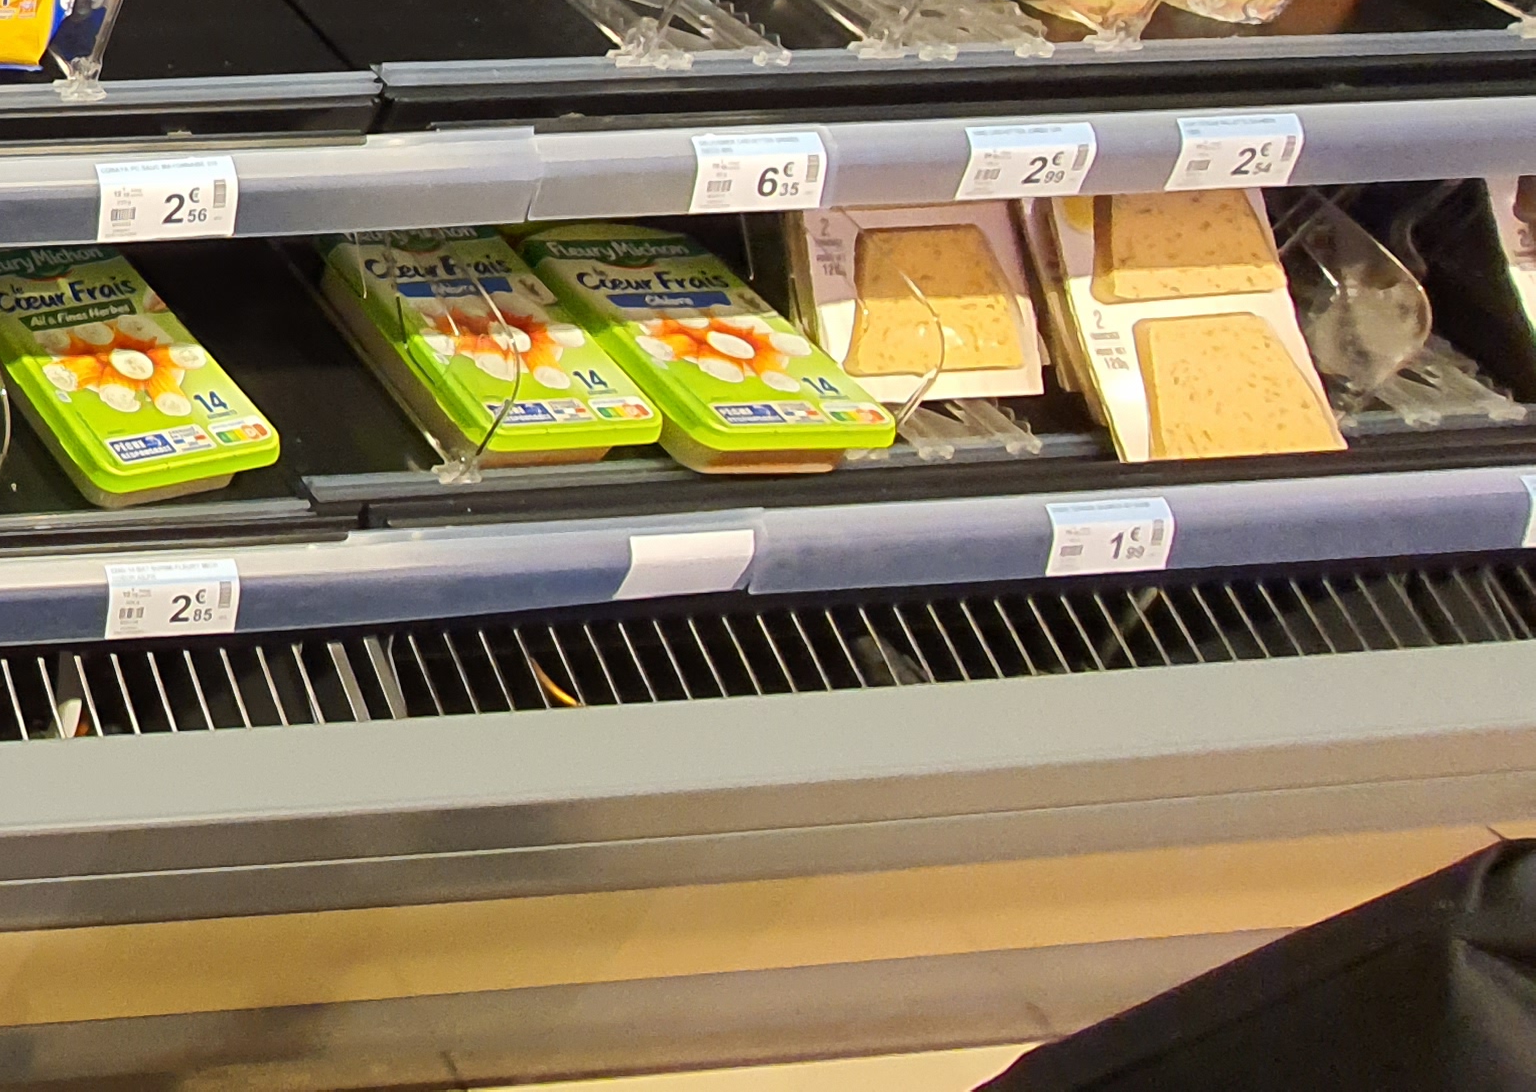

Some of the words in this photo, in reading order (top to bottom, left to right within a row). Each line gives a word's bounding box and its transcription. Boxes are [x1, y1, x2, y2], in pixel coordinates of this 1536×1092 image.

[29, 247, 105, 269] Michon
[545, 240, 616, 261] Fleury
[610, 239, 690, 256] Michon
[68, 275, 137, 303] Frais
[652, 269, 730, 292] Frais
[56, 310, 88, 324] Fines
[572, 369, 609, 389] 14
[801, 376, 841, 396] 14
[192, 390, 229, 413] 14
